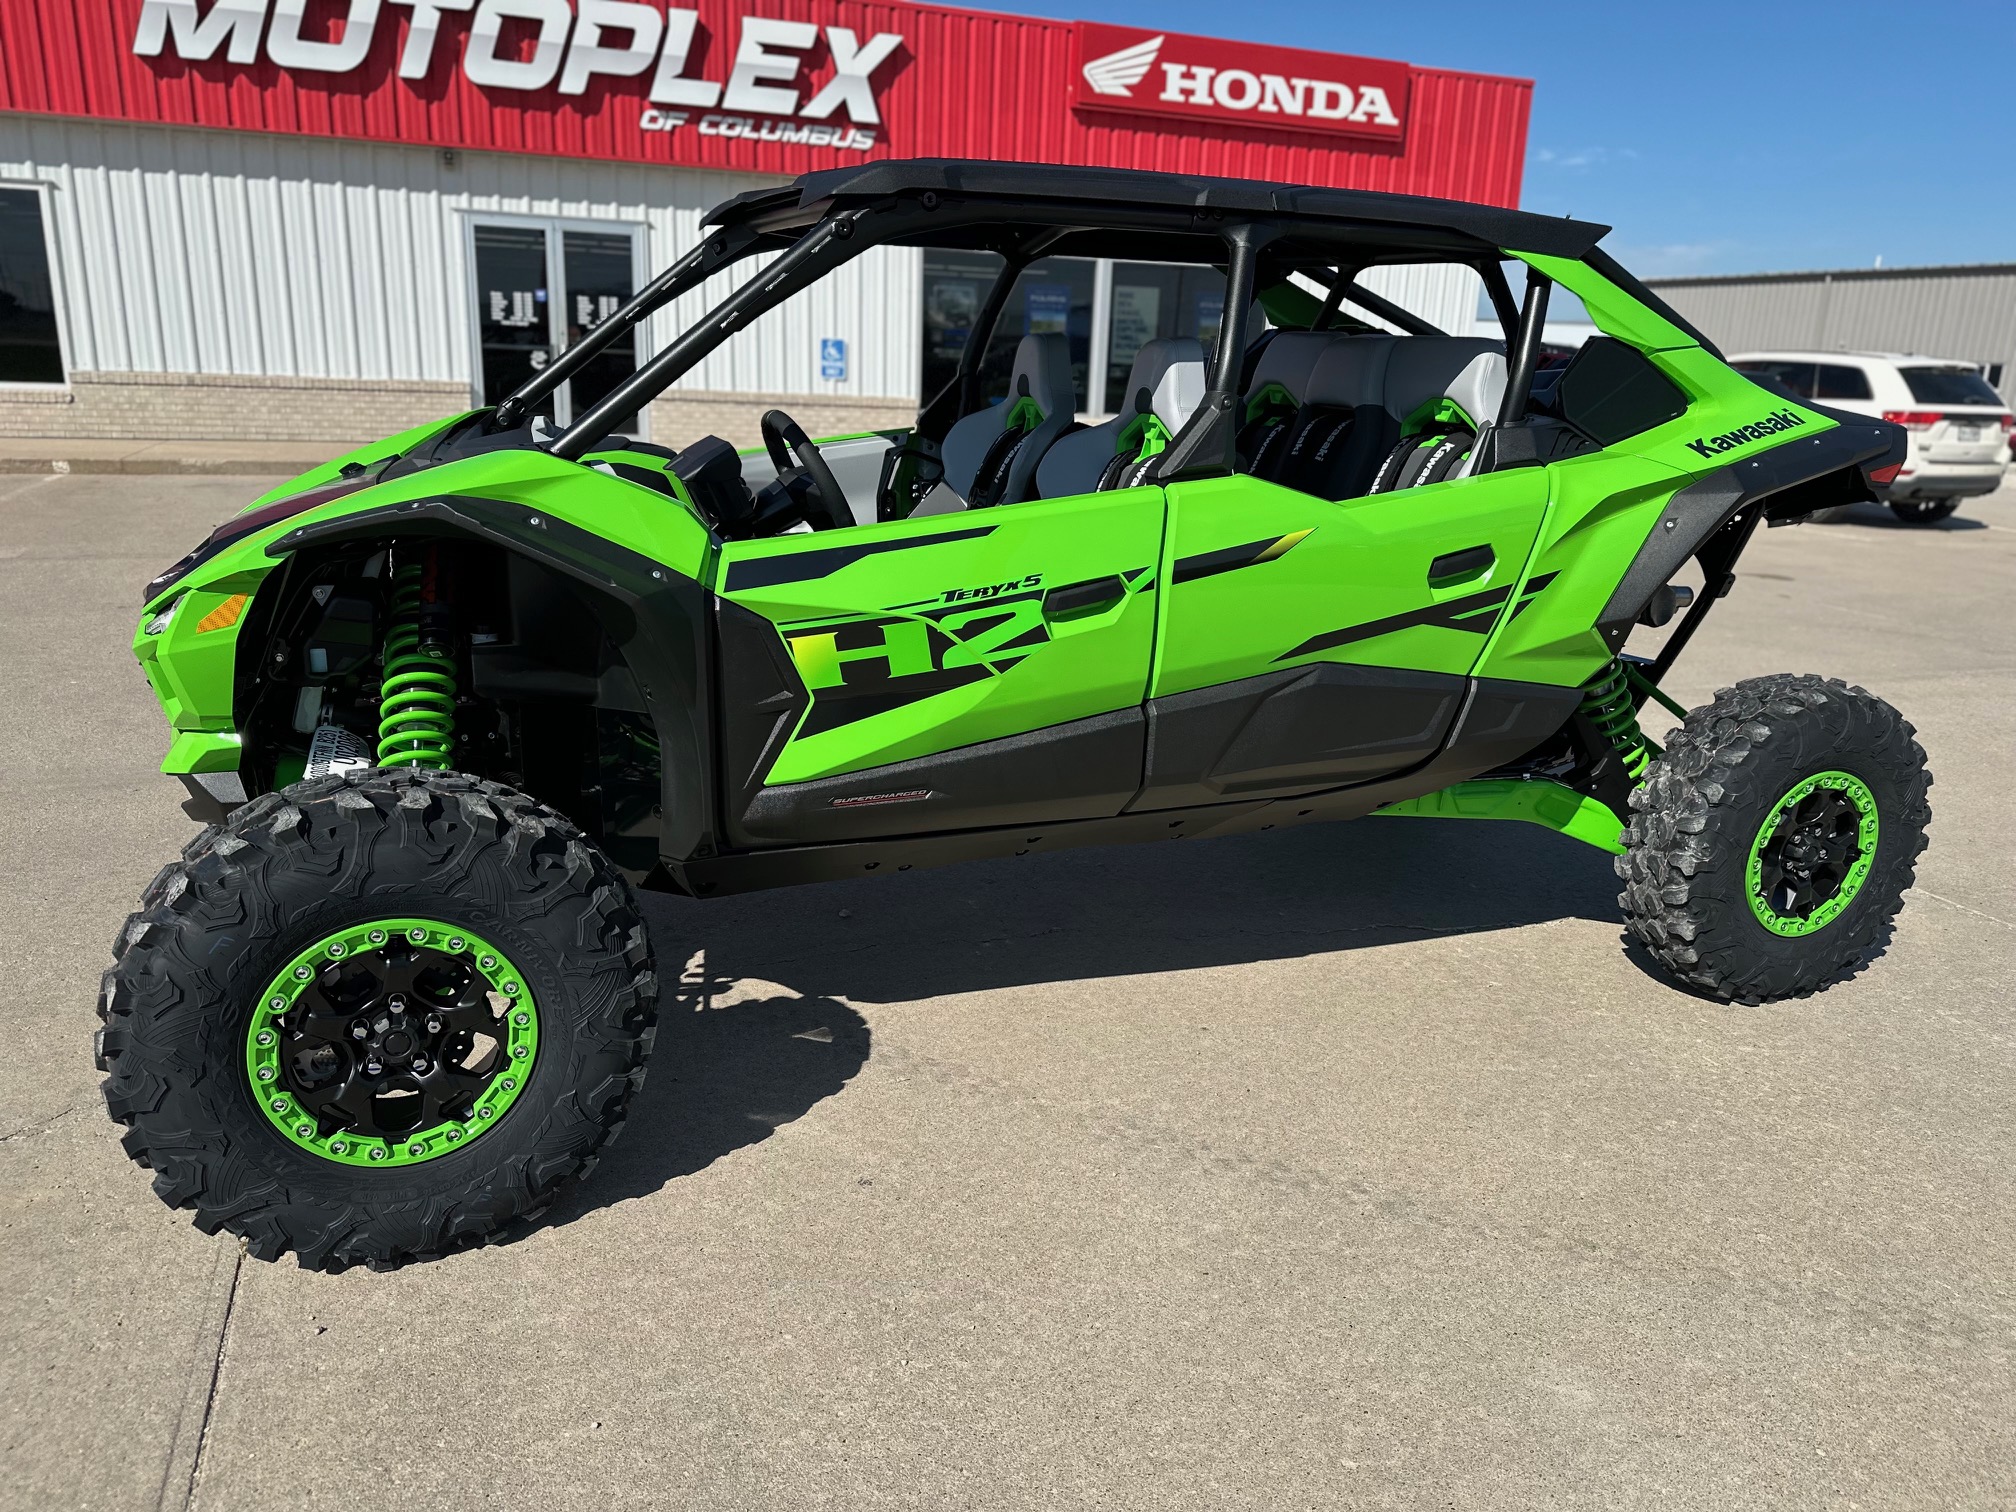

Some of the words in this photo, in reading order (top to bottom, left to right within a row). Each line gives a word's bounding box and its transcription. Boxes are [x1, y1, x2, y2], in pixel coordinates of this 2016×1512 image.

[133, 0, 903, 124] MOTOPLEX
[1159, 62, 1399, 126] HONDA
[640, 109, 687, 131] OF
[698, 114, 876, 151] COLUMBUS
[1685, 408, 1806, 458] Kawasaki
[787, 599, 1052, 690] H2
[834, 790, 927, 803] SUPERCHARGED
